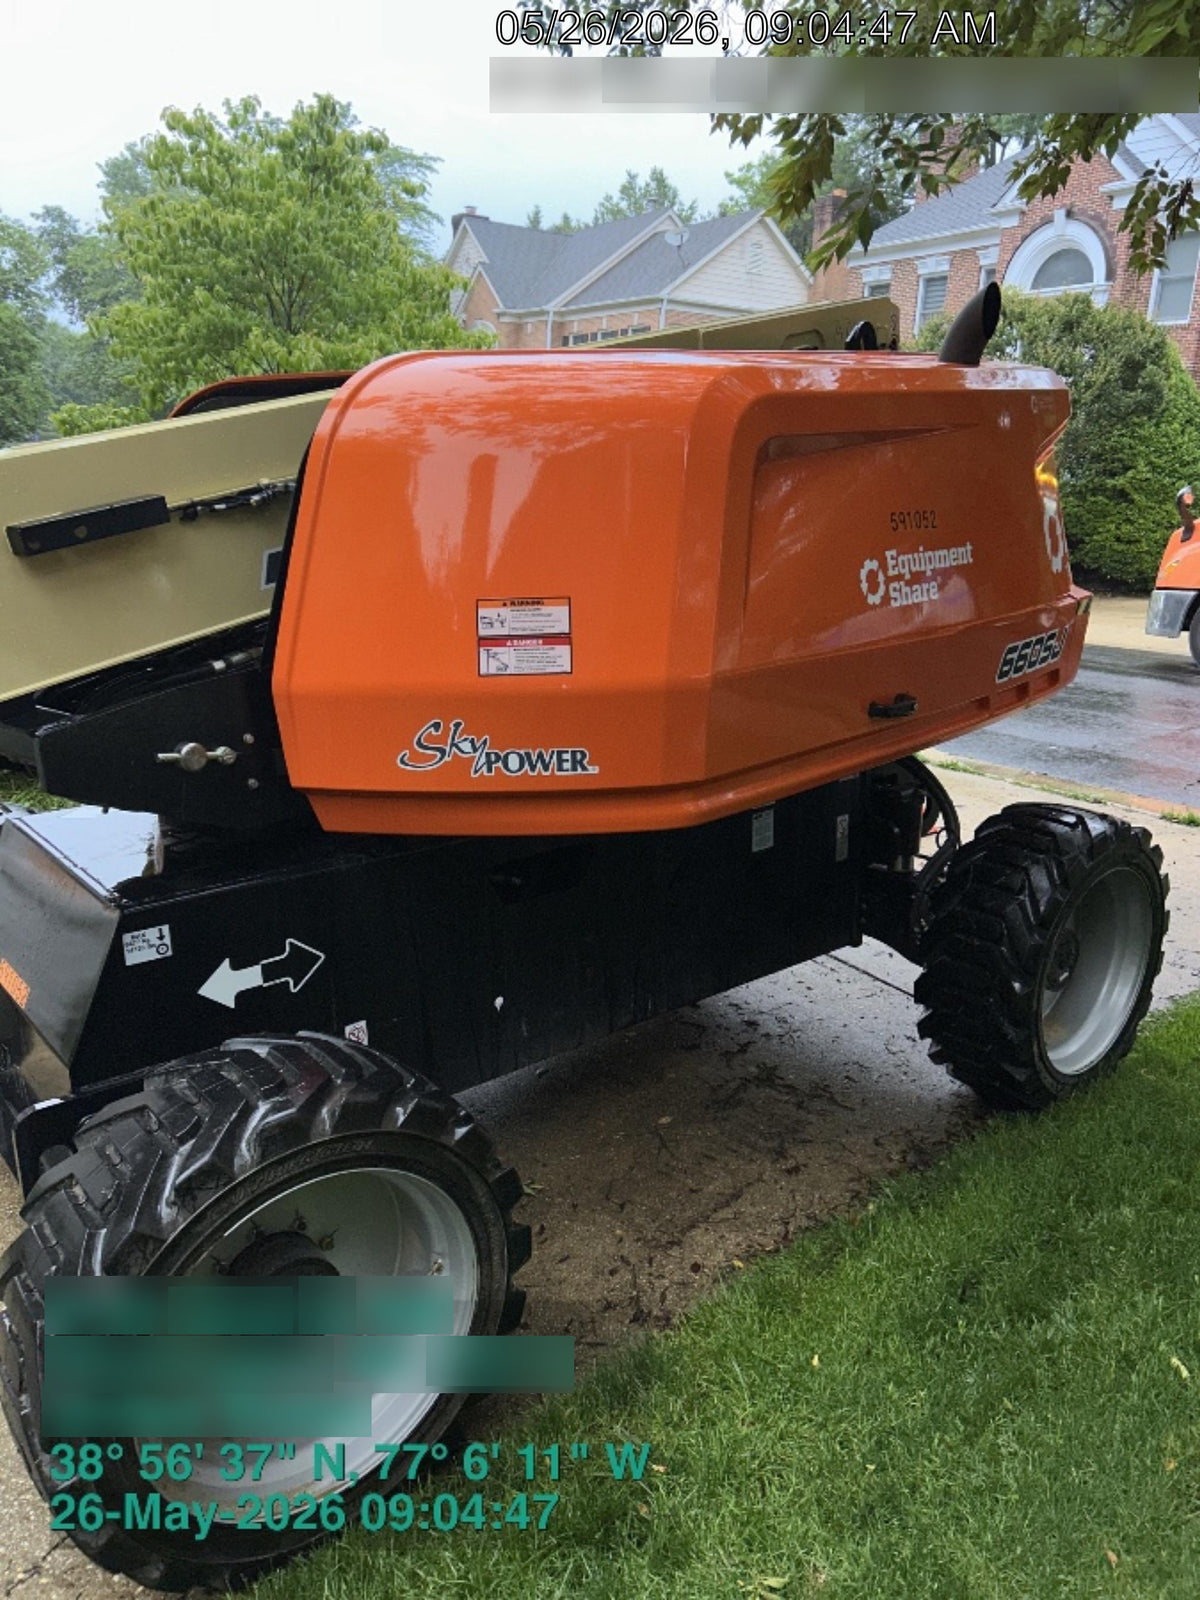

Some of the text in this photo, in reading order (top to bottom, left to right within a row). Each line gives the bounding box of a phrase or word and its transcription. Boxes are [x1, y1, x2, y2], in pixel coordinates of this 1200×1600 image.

[890, 510, 938, 532] 591052
[885, 541, 973, 579] Equipment
[889, 581, 939, 607] Share
